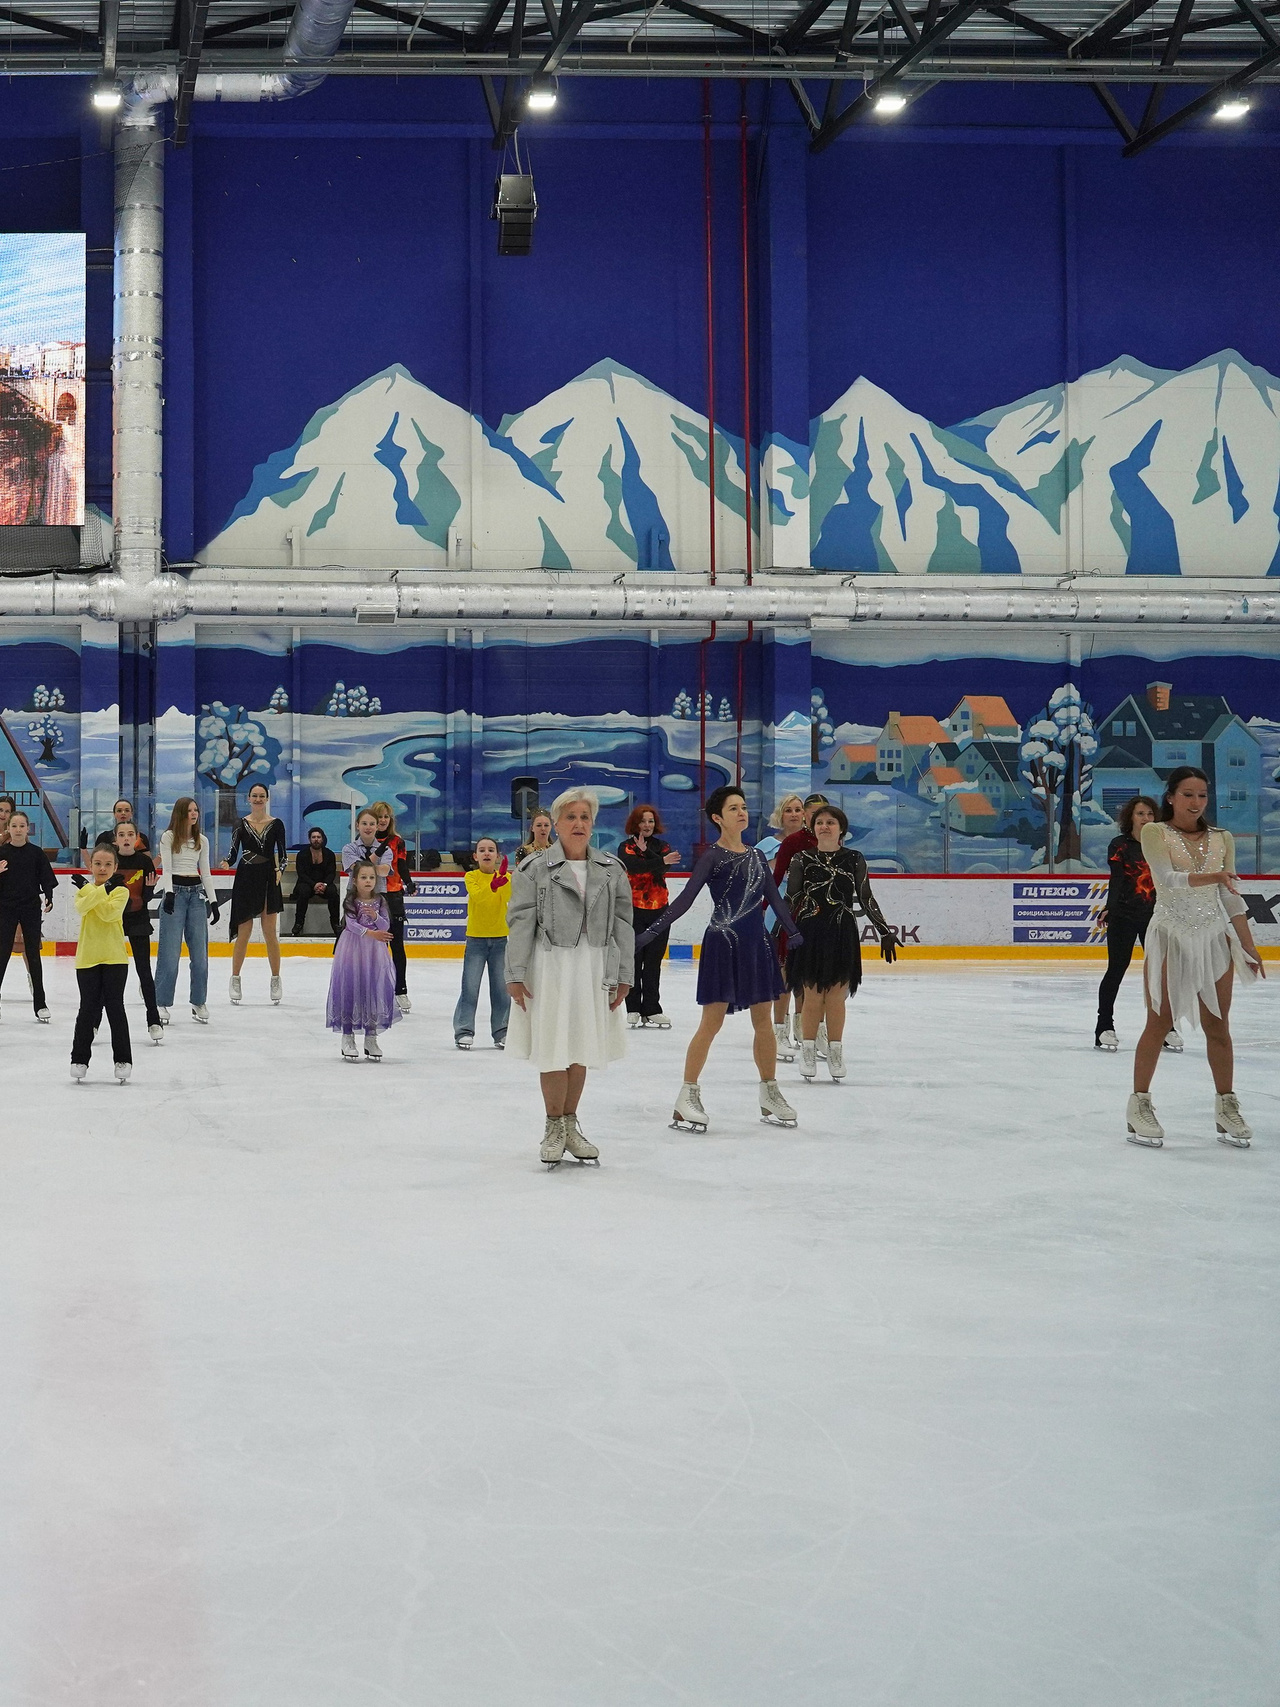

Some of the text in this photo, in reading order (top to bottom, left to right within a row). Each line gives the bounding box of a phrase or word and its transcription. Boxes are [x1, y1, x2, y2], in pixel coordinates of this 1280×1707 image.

[419, 885, 460, 894] ТЕХНО
[1040, 887, 1079, 896] ТЕХНО
[417, 929, 452, 938] XCMG
[1037, 930, 1073, 939] XCMG
